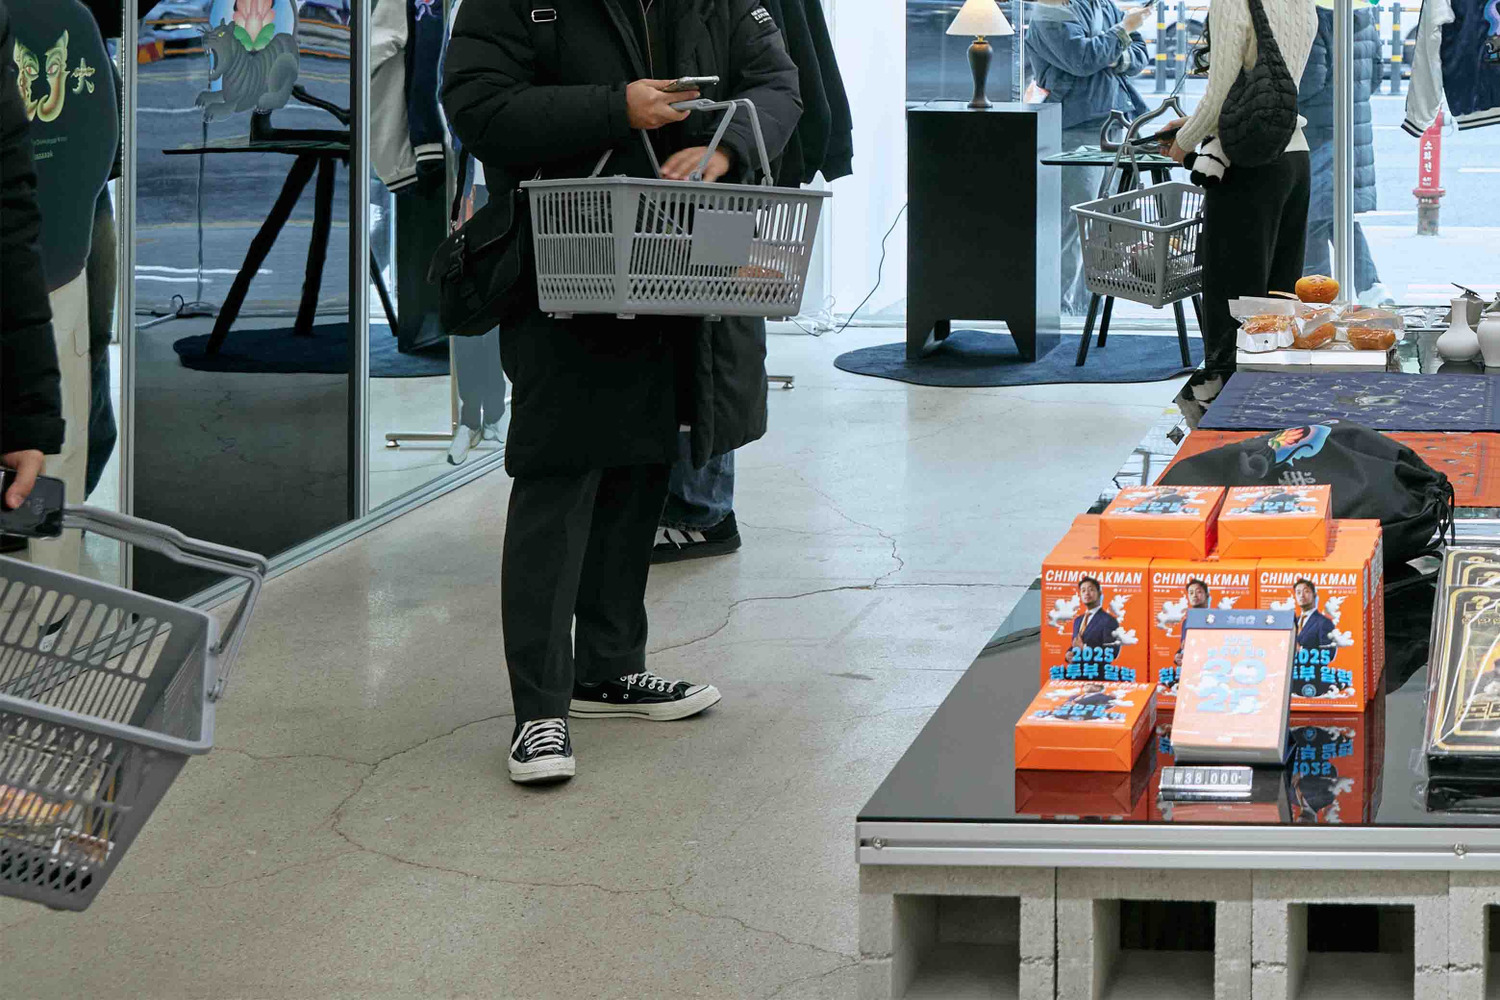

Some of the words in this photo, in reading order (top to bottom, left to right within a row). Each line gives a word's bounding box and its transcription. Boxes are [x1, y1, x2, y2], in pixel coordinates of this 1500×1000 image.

[1045, 570, 1142, 584] CHIMCHAKMAN
[1153, 572, 1250, 586] CHIMCHAKMAN
[1260, 572, 1357, 586] CHIMCHAKMAN
[1072, 646, 1115, 663] 2025
[1295, 648, 1331, 665] 025
[1104, 664, 1137, 683] 일력
